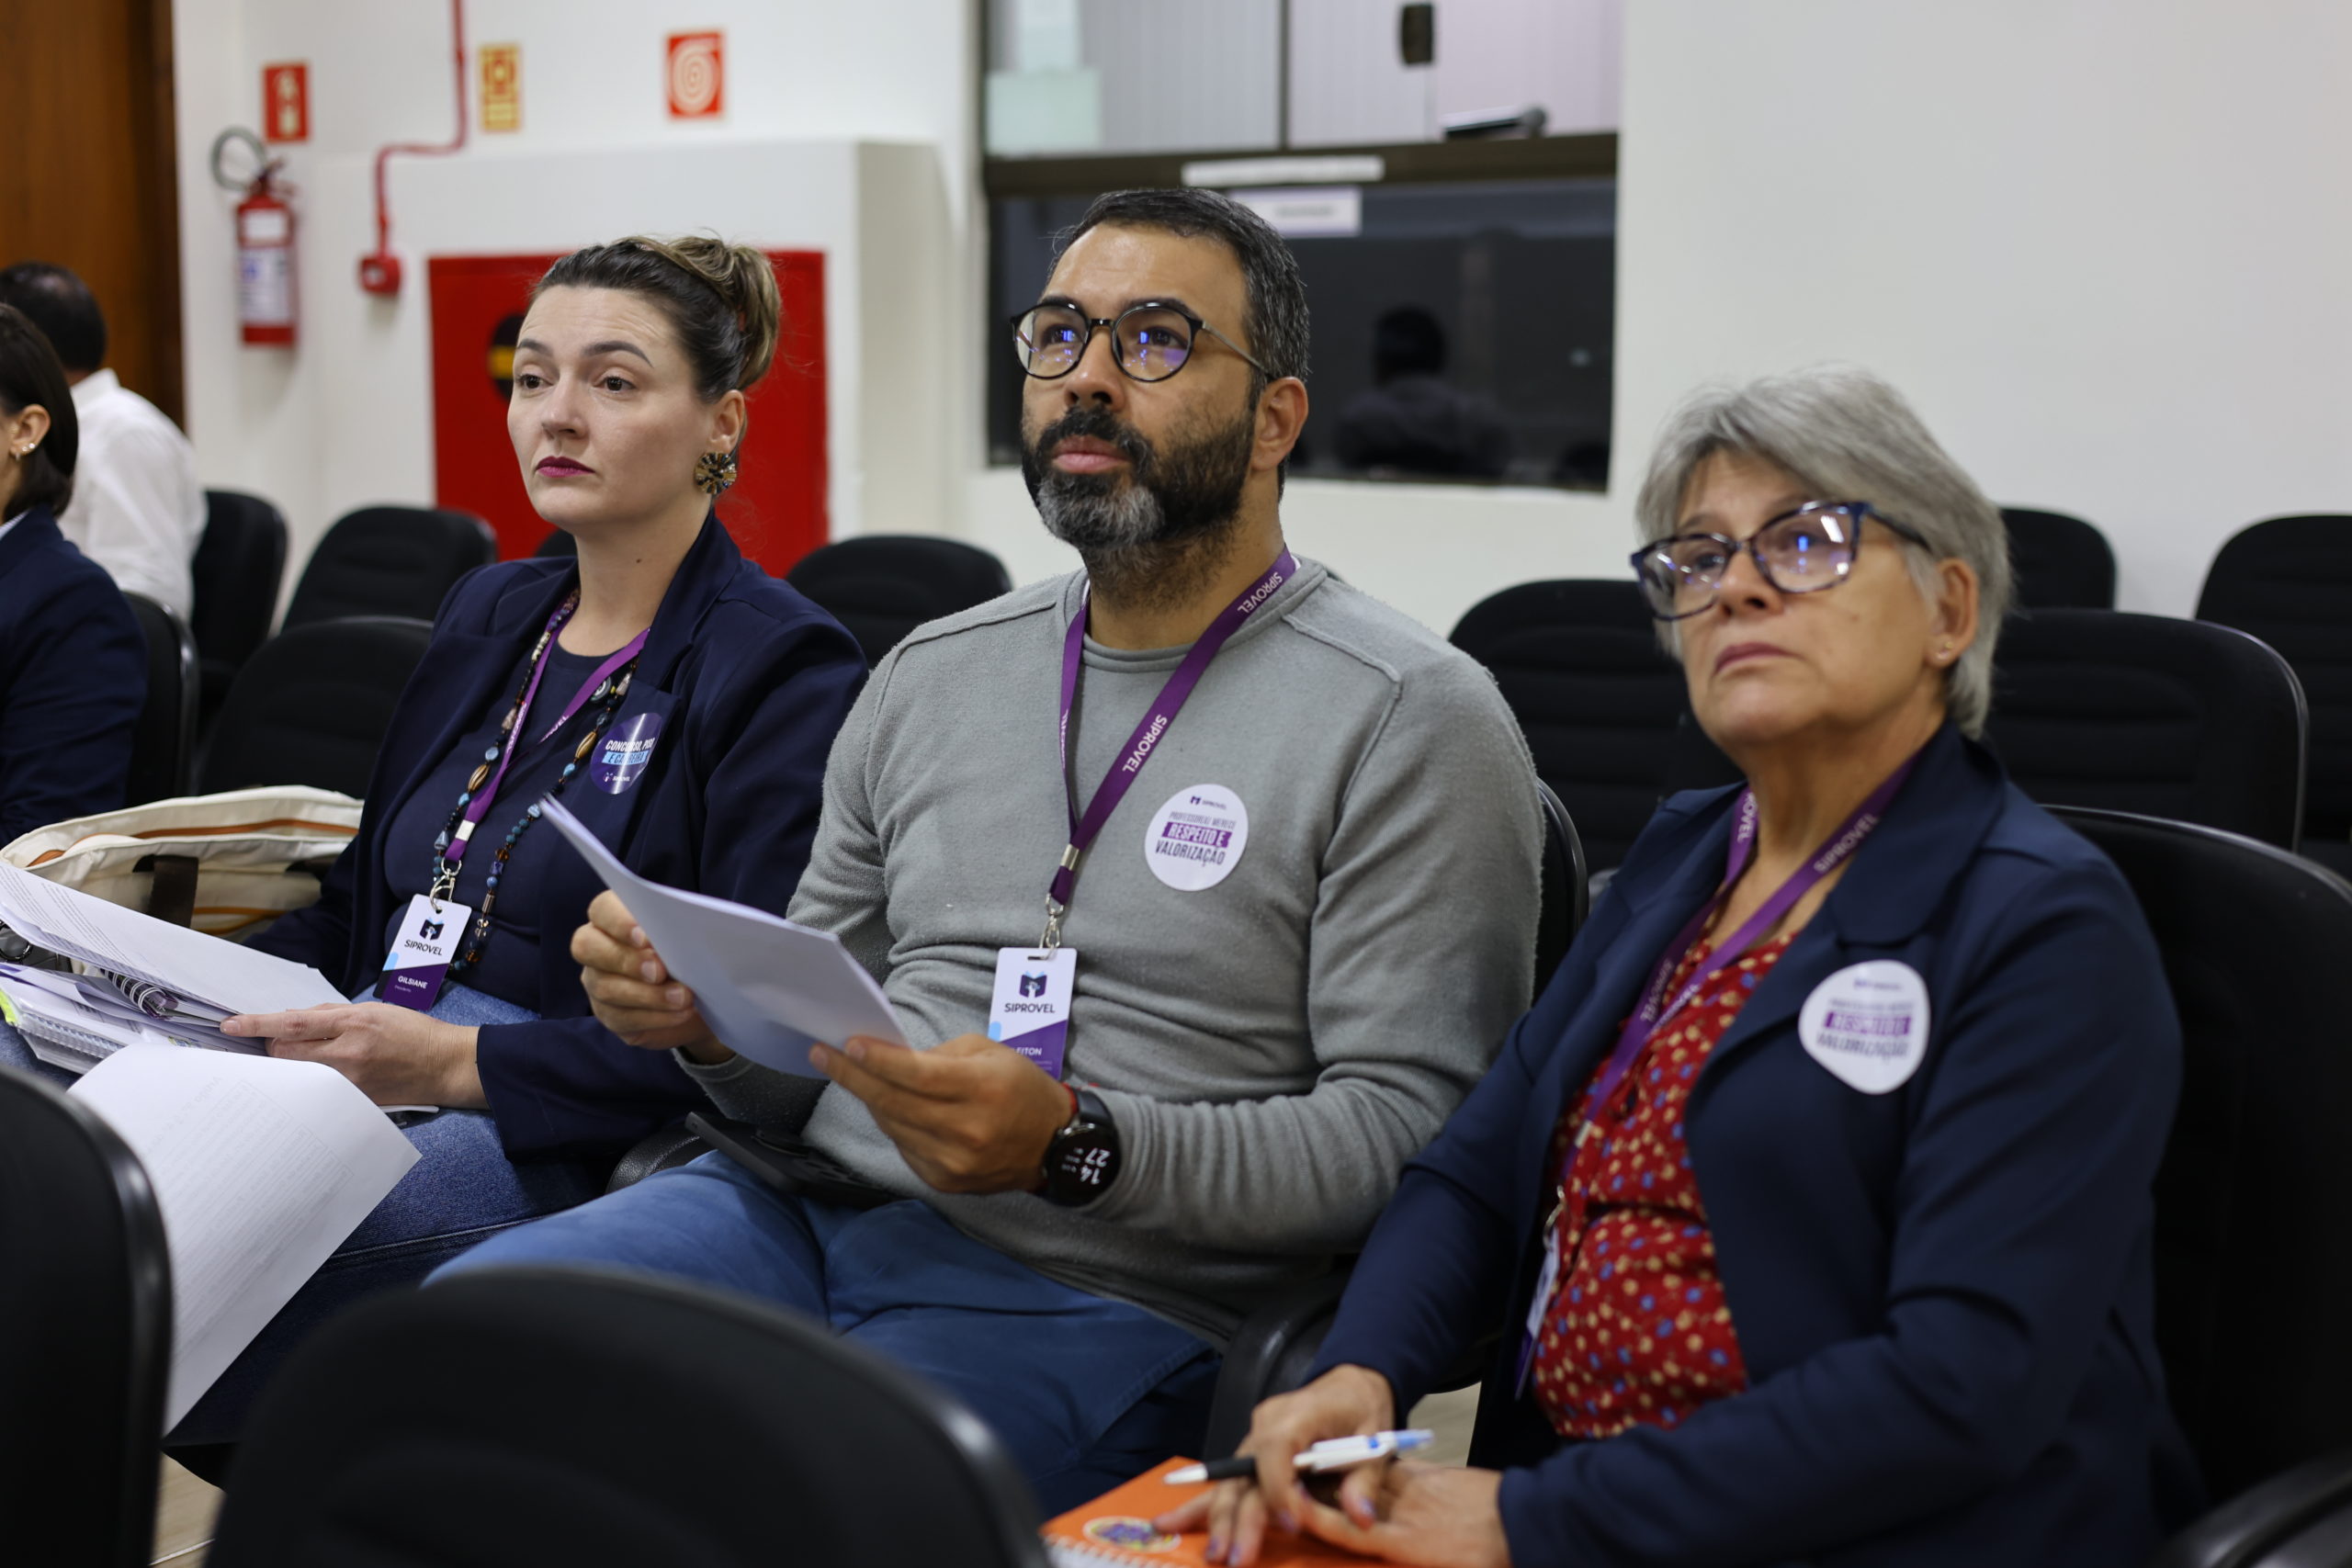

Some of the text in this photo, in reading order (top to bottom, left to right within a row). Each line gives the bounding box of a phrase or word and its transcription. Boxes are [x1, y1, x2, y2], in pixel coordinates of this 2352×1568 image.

[1237, 571, 1283, 615] SIPROVEL
[1122, 714, 1168, 773] SIPROVEL
[1167, 823, 1227, 848] RESPEITO E
[404, 939, 443, 956] SIPROVEL
[1003, 1002, 1056, 1014] SIPROVEL
